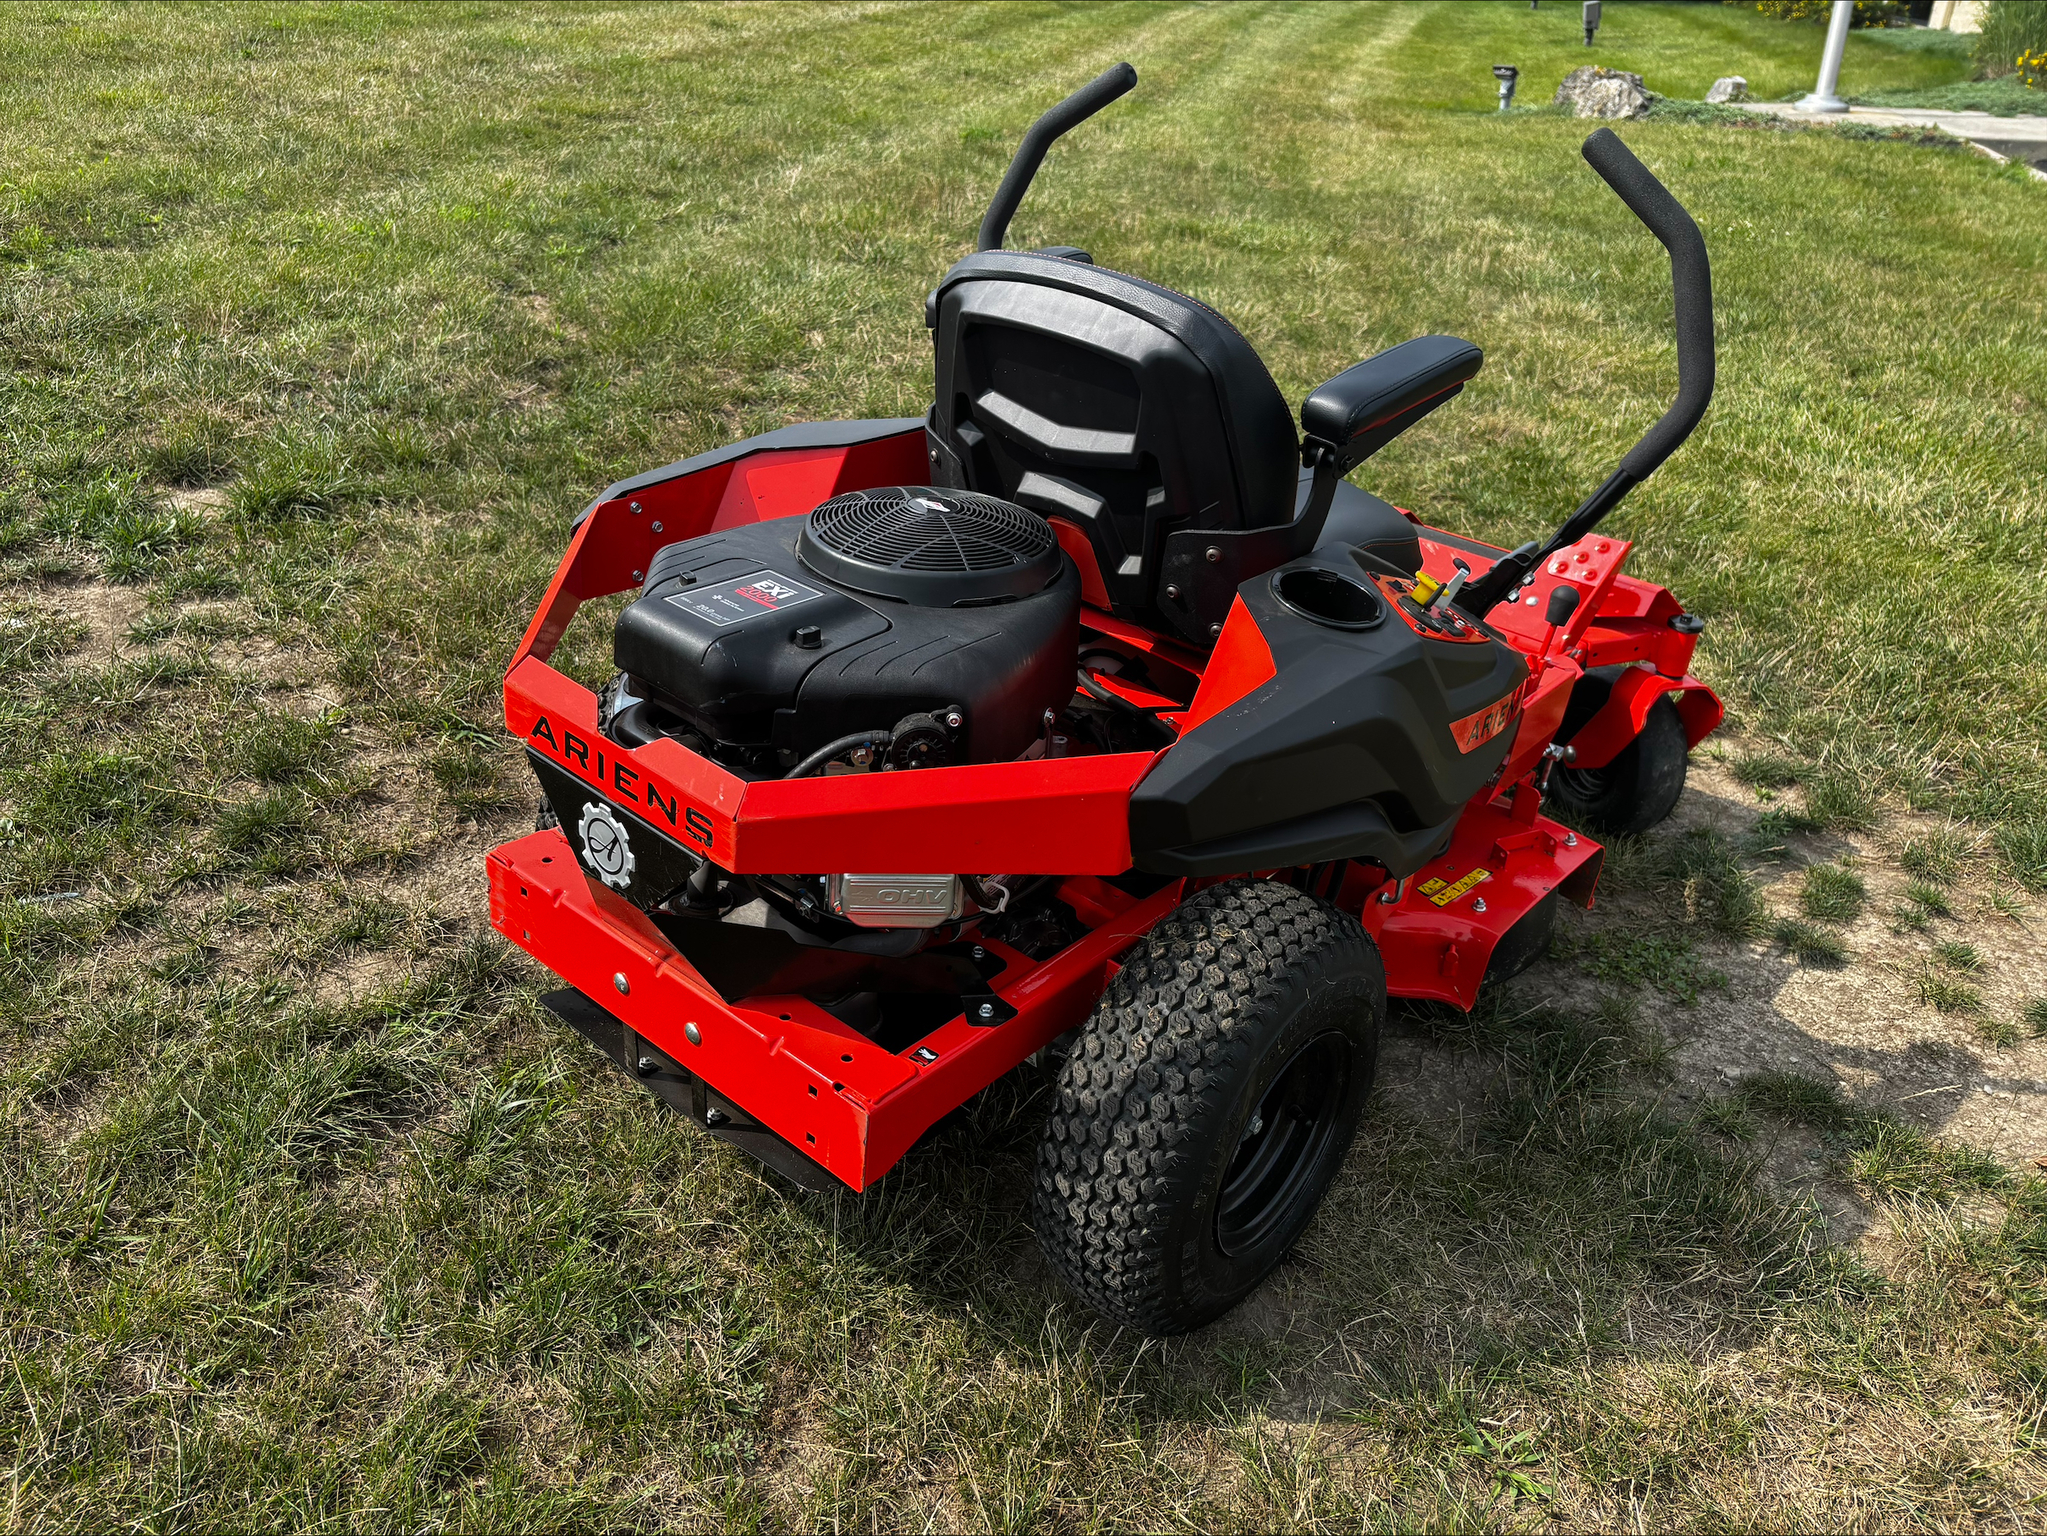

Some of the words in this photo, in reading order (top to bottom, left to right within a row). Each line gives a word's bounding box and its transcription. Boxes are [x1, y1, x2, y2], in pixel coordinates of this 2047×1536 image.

[740, 585, 778, 603] 2000
[1466, 693, 1521, 746] ARIEN
[531, 715, 714, 850] ARIENS
[877, 889, 948, 905] OHV
